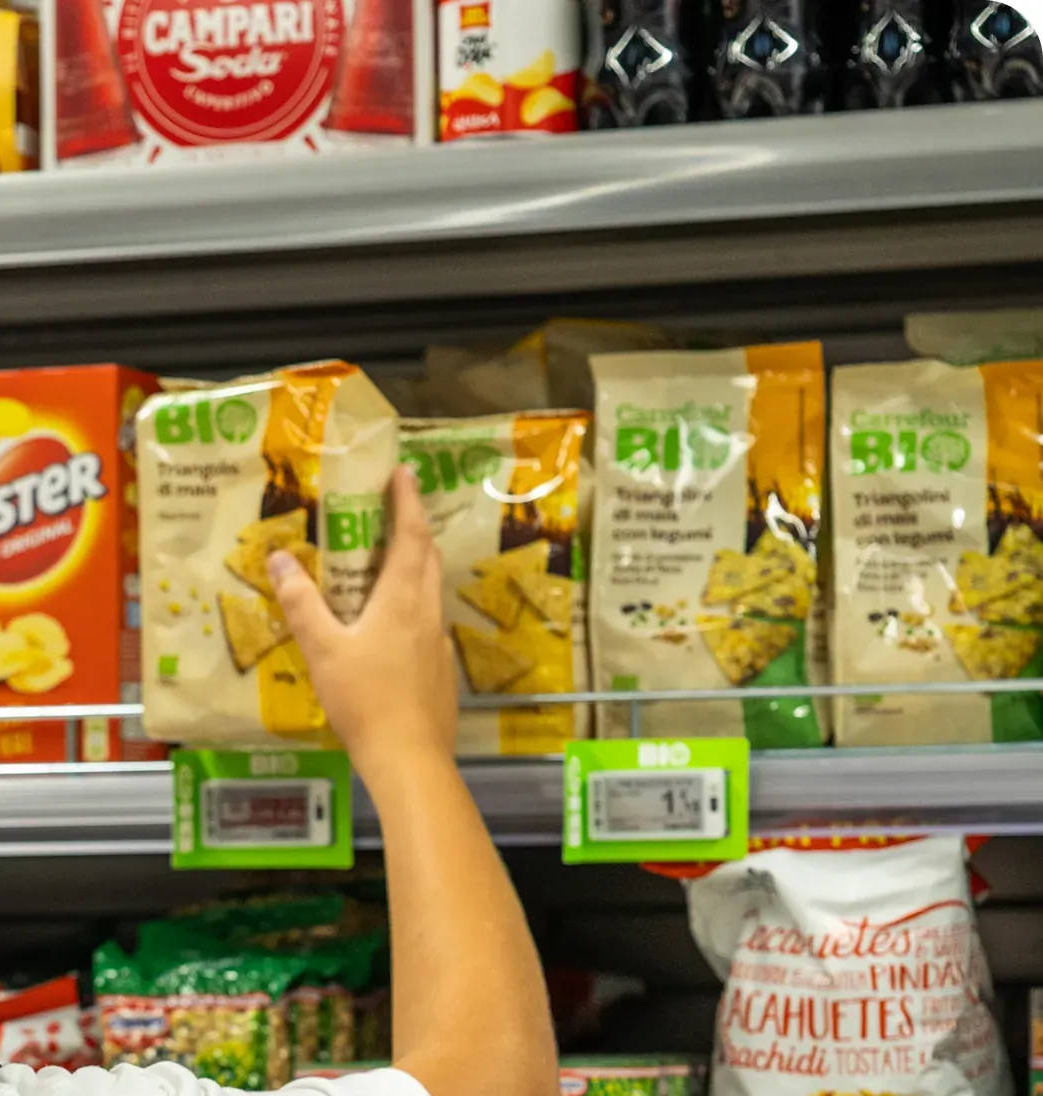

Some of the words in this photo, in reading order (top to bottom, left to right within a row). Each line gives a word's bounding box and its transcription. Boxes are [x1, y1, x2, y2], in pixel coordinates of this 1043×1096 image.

[144, 2, 314, 54] CAMPARI
[169, 41, 286, 83] Soda
[154, 398, 257, 444] BIO
[850, 409, 969, 428] Carrefour
[616, 426, 730, 471] BIO
[851, 430, 971, 475] BIO
[853, 488, 950, 509] Triangolini
[1, 519, 75, 561] ORIGINAL
[894, 529, 955, 549] legumi
[834, 1046, 915, 1074] TOSTATE
